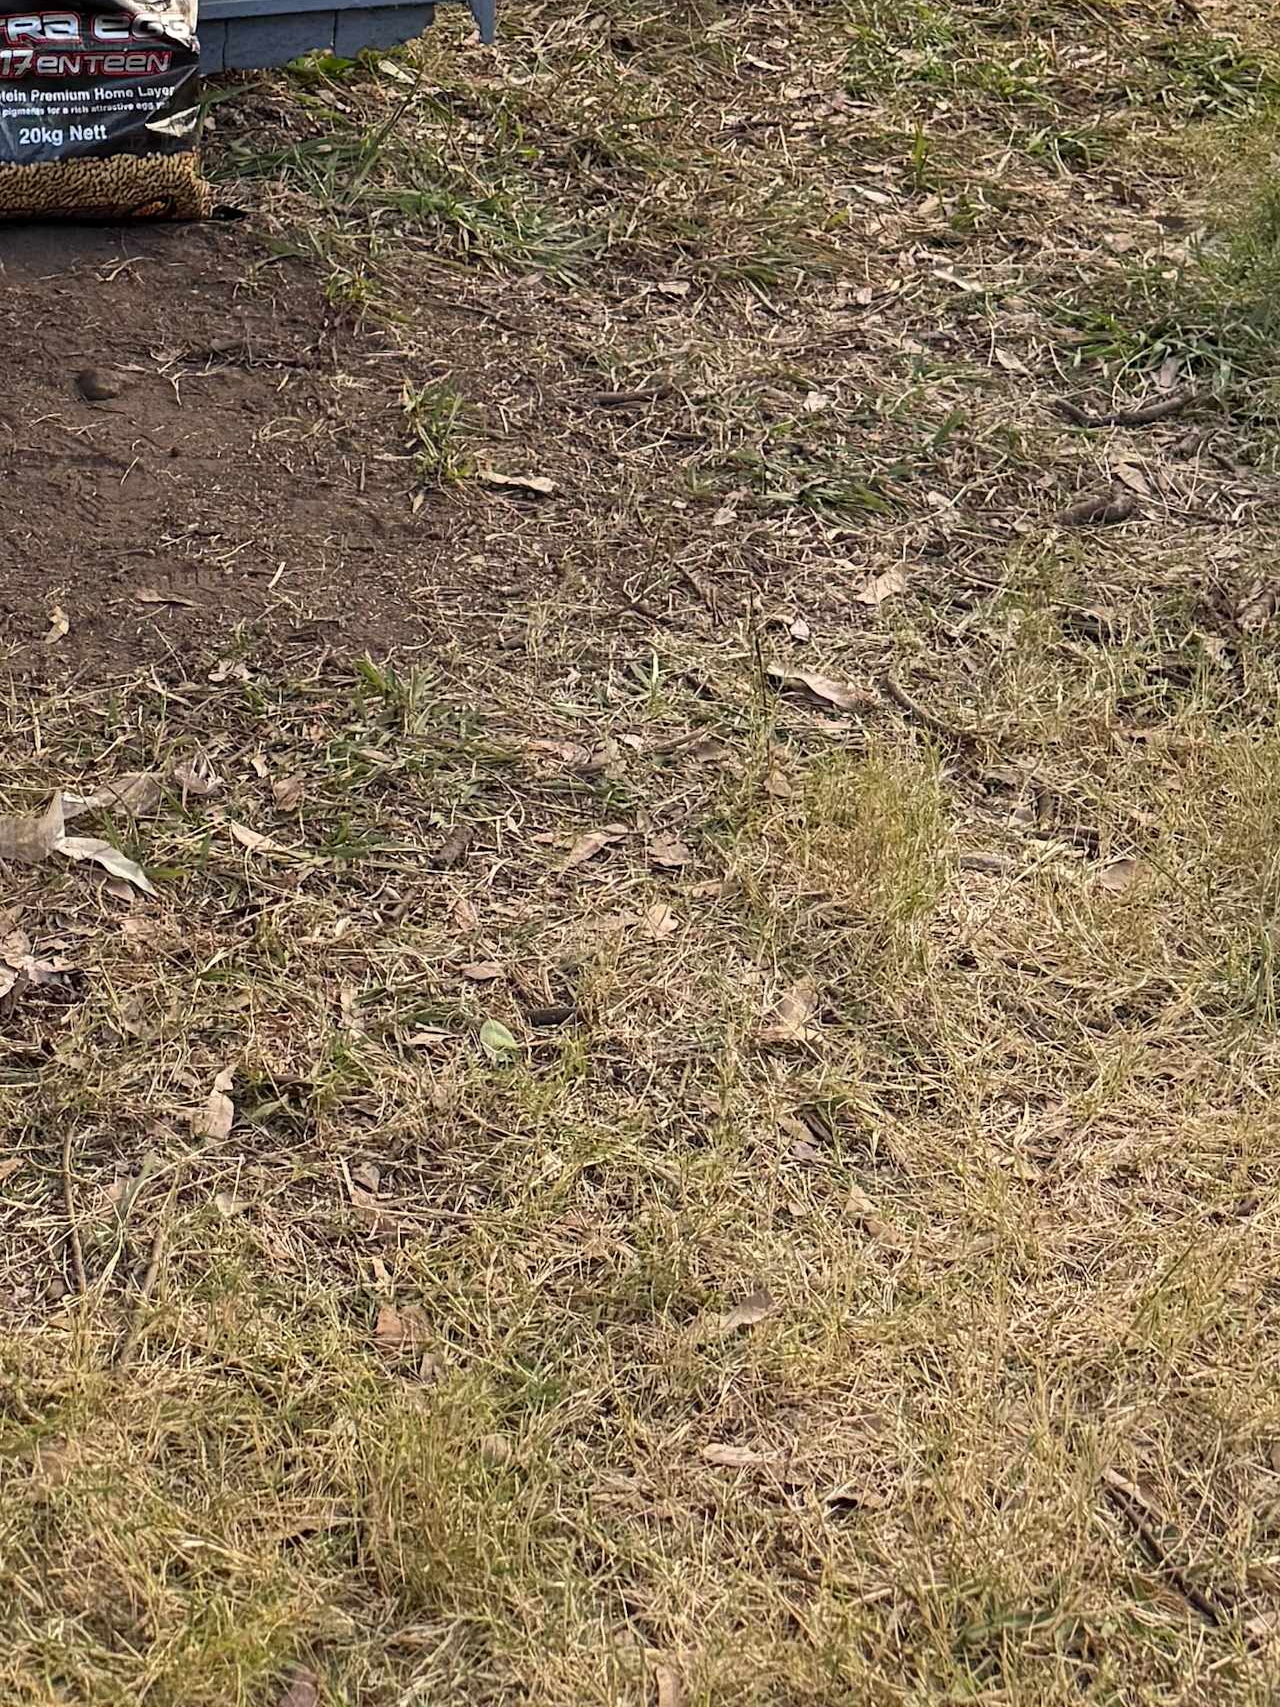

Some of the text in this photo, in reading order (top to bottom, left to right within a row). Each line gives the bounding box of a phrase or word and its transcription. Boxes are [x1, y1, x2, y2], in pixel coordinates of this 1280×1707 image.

[30, 89, 91, 102] Premium
[94, 88, 134, 101] Home
[138, 86, 175, 99] Layer
[71, 105, 89, 114] rich
[19, 124, 108, 146] 20kg Nett
